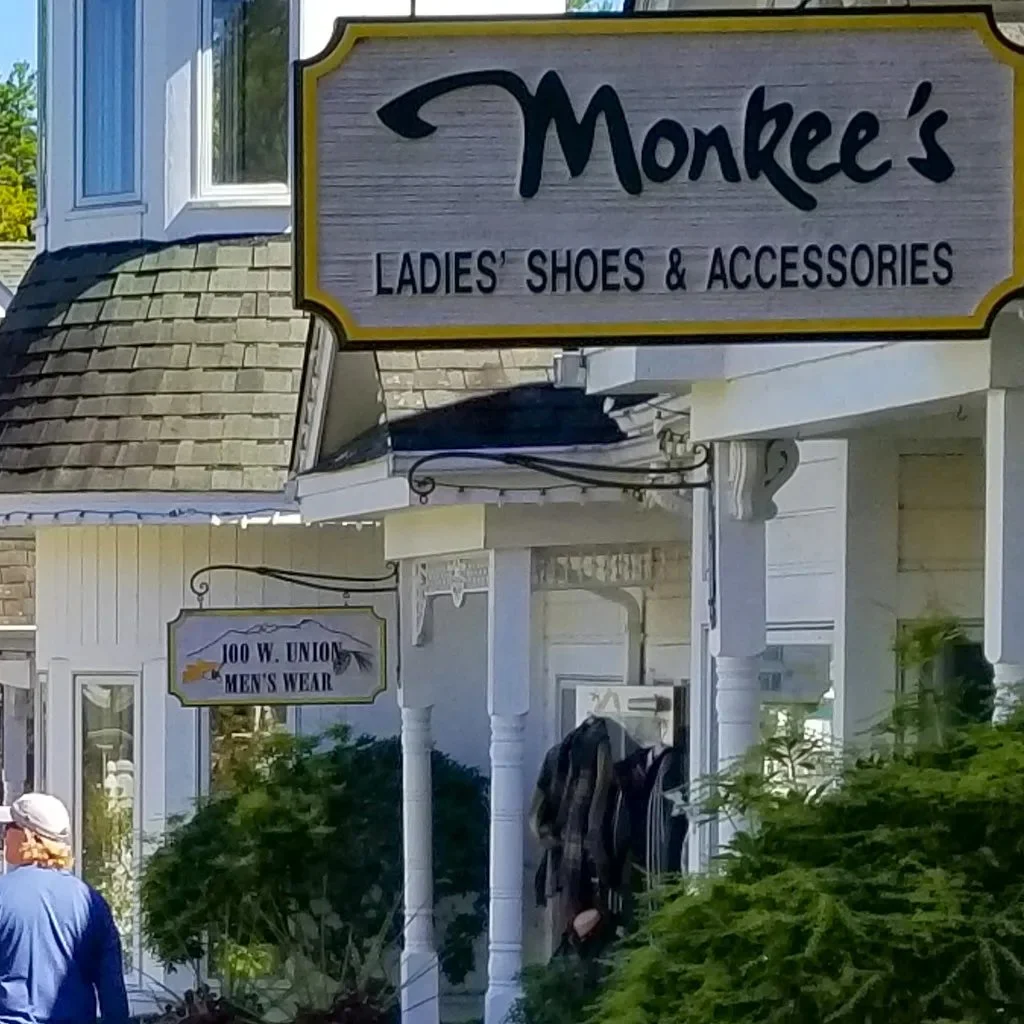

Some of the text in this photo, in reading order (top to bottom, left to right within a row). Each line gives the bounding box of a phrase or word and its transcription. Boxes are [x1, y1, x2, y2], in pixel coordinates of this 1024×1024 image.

[376, 68, 956, 212] Monkee's
[374, 241, 955, 297] LADIES' SHOES & ACCESSORIES
[222, 641, 342, 665] 100 W. UNION
[225, 672, 334, 694] MEN'S WEAR
